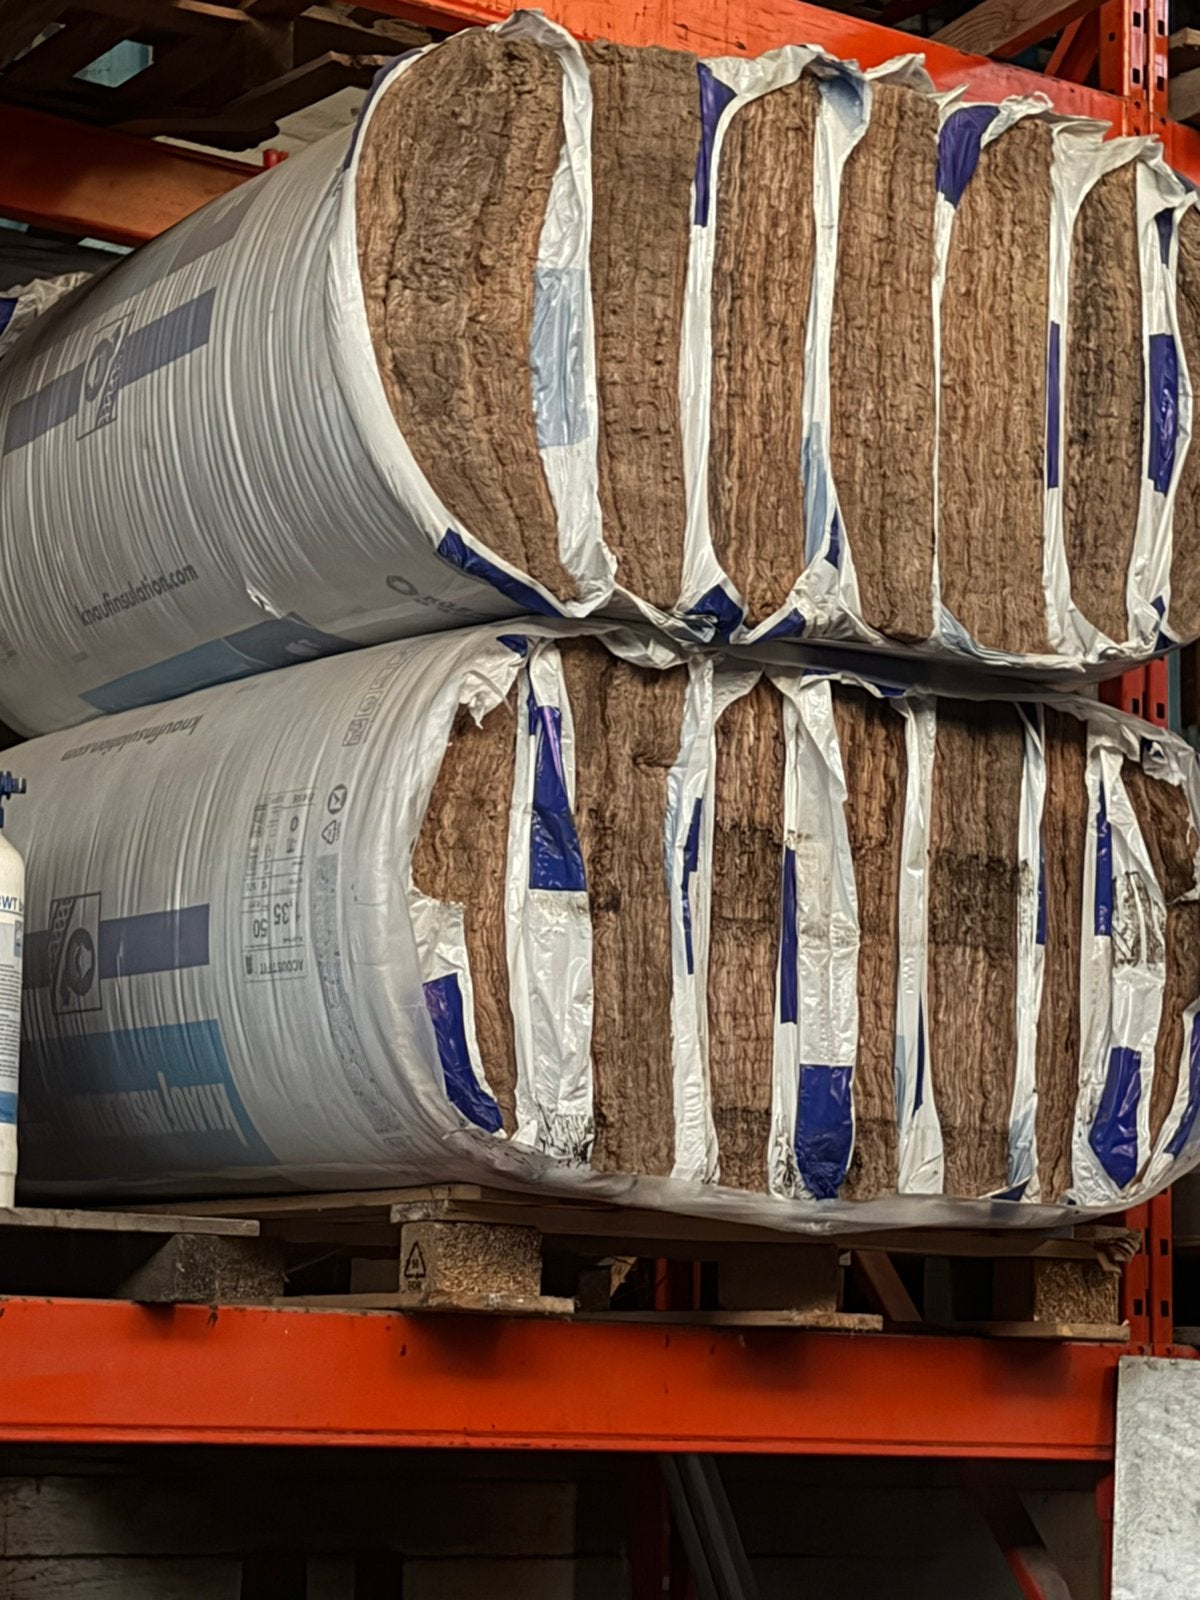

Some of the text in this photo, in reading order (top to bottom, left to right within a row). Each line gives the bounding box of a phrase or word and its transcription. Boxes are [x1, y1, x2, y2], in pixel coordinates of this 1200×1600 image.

[74, 564, 199, 626] knaufinsulation.com
[0, 895, 17, 911] WT
[253, 918, 268, 938] 50
[63, 1071, 249, 1148] KNAUFINSUL
